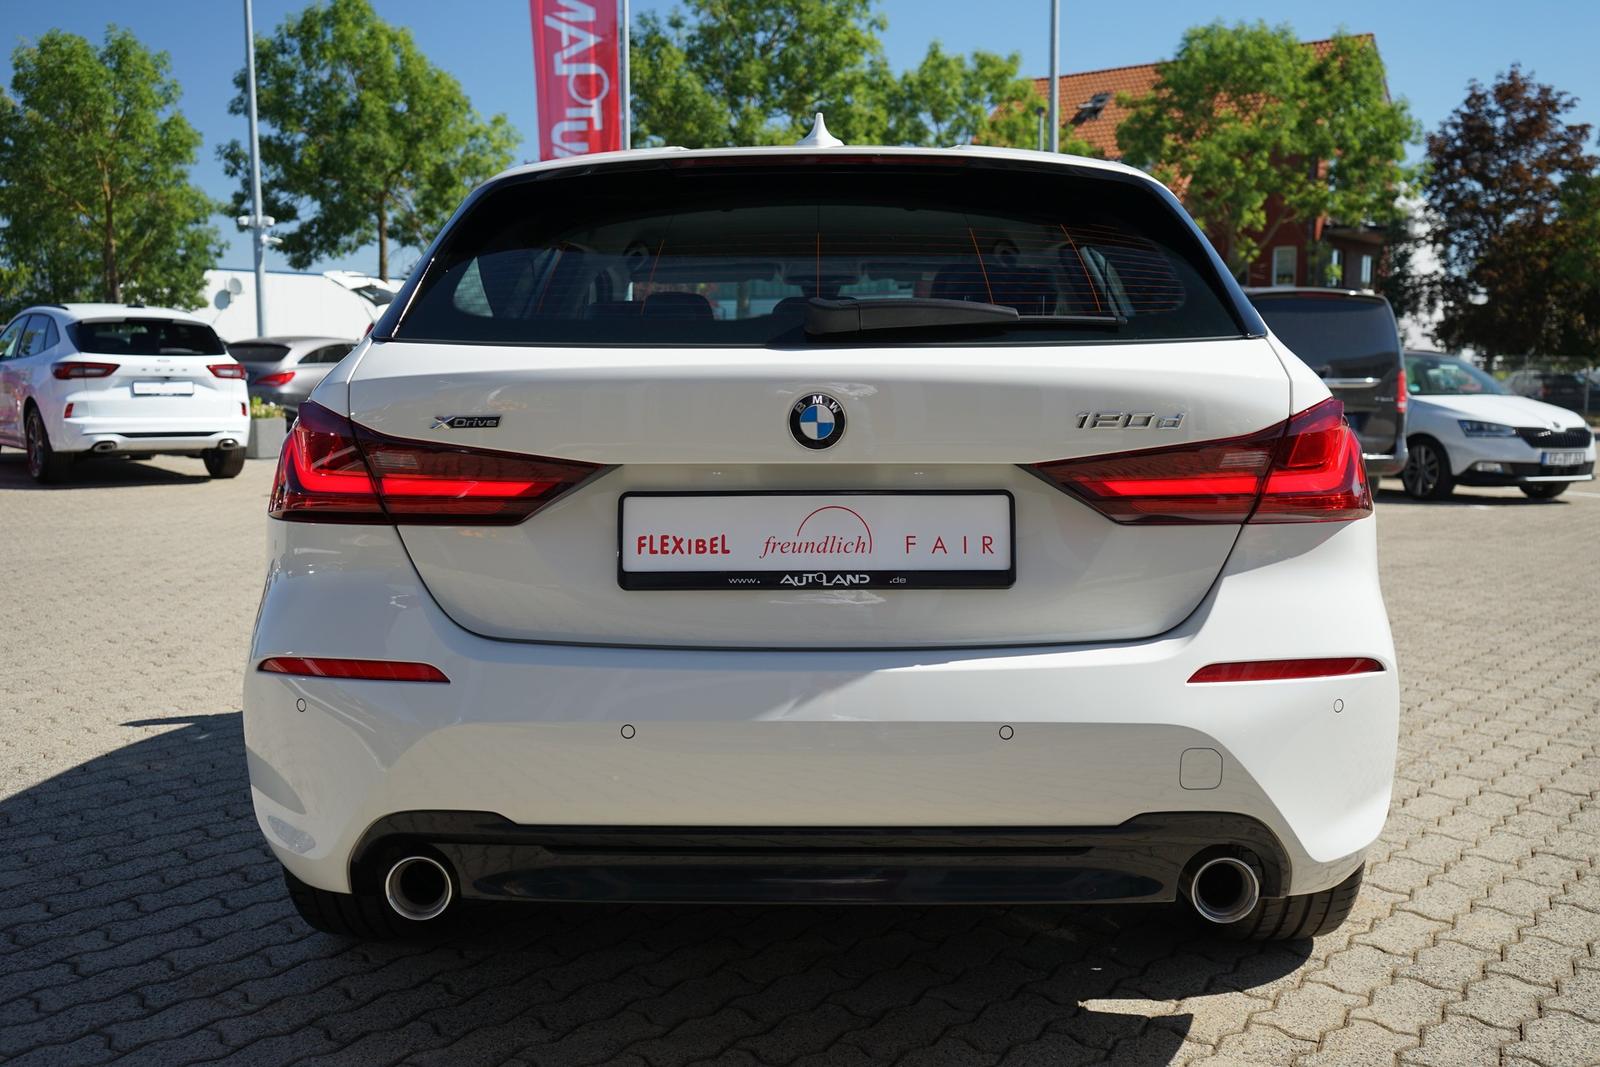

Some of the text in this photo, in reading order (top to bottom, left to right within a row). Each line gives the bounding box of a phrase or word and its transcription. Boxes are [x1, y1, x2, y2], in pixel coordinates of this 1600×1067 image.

[794, 395, 841, 414] BMW
[1074, 411, 1185, 430] 120d
[637, 534, 994, 559] FLEXIBEL freundlich FAIR
[780, 572, 871, 587] AUTOLAND
